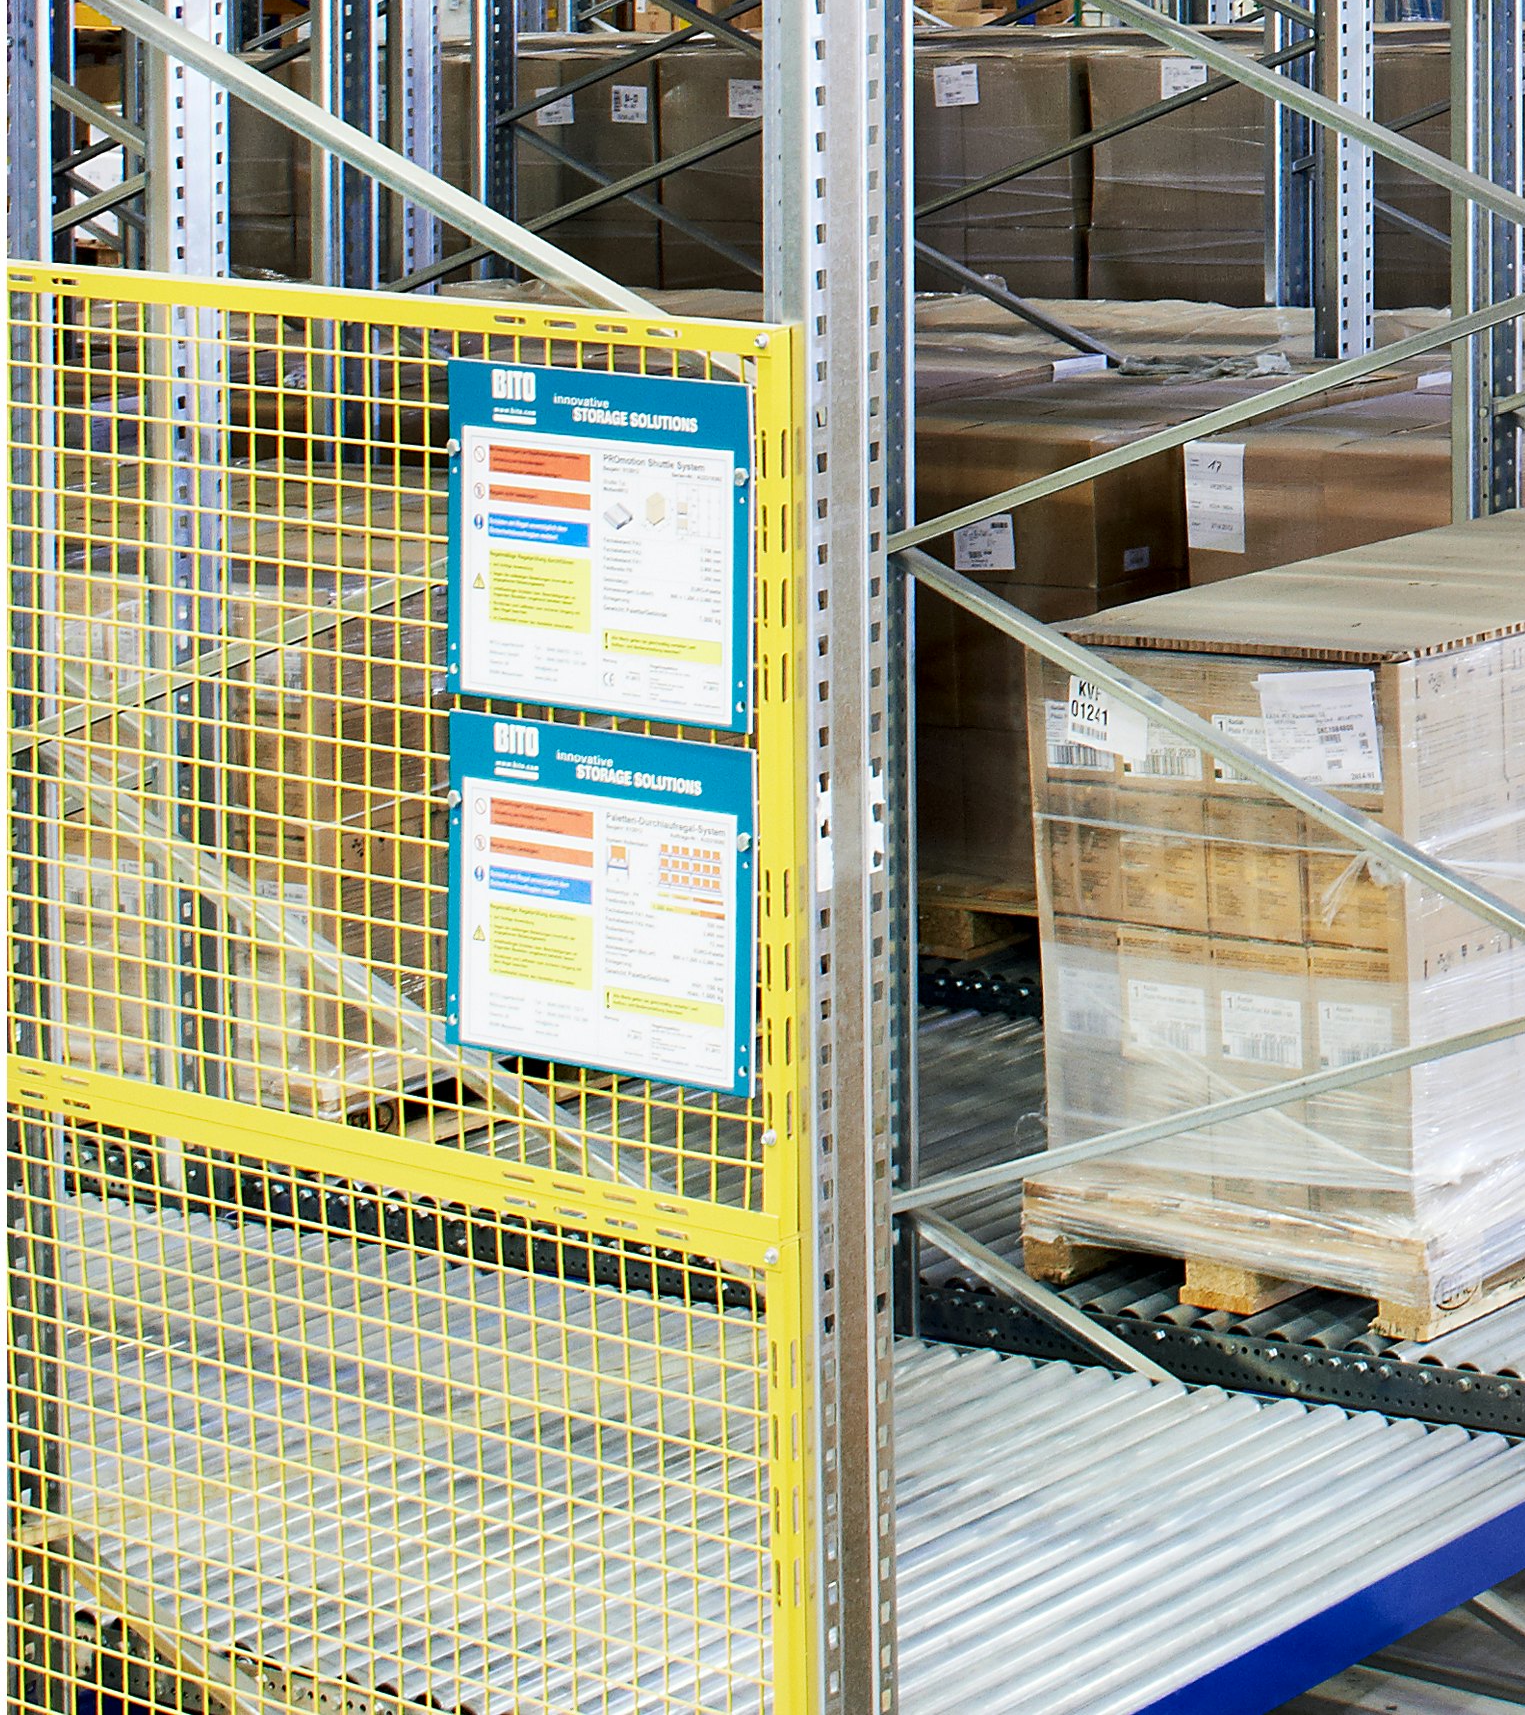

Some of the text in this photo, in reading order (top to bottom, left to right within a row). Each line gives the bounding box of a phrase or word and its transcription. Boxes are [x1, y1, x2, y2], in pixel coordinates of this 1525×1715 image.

[491, 369, 536, 403] BITO
[553, 393, 610, 410] innovative
[572, 407, 698, 434] STORAGE SOLUTIONS
[602, 452, 706, 475] PROmotion Shuttle System
[1071, 699, 1108, 726] 01241
[1217, 720, 1224, 731] 1
[493, 722, 540, 758] BITO
[556, 749, 614, 767] innovative
[576, 764, 703, 796] STORAGE SOLUTIONS
[1132, 986, 1139, 997] 1
[1227, 997, 1234, 1009] 1
